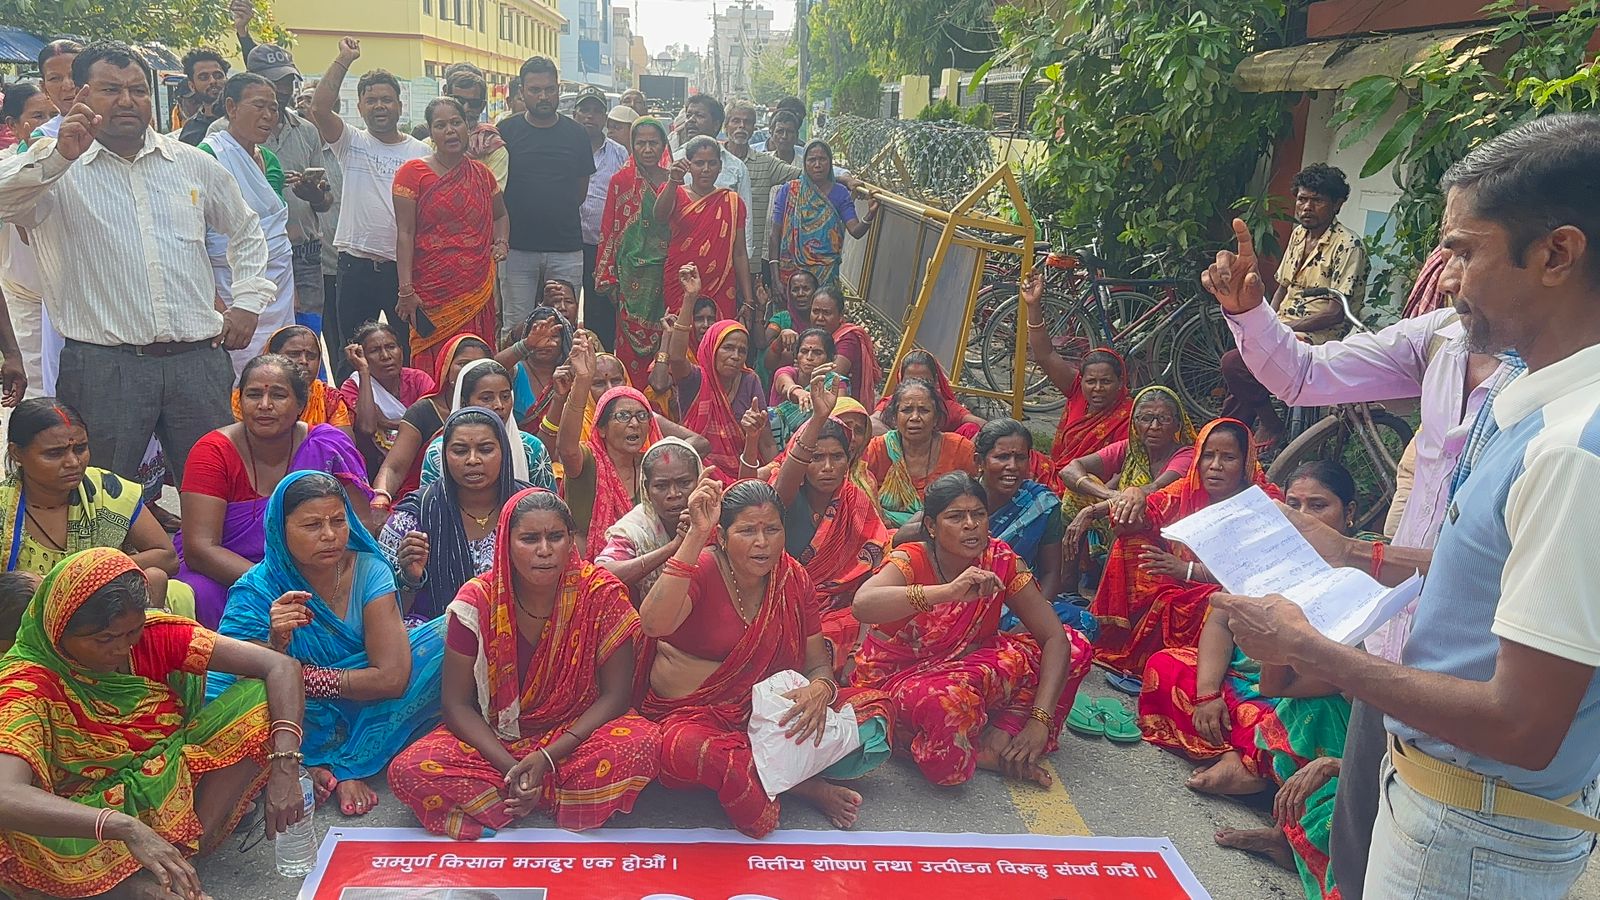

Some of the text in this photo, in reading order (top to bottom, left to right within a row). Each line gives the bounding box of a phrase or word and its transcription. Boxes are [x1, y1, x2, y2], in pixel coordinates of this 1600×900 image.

[371, 854, 436, 873] सम्पुर्ण
[439, 854, 507, 868] किसान
[513, 858, 576, 873] मजदुर
[582, 858, 615, 869] एक
[748, 856, 805, 870] वित्तीय
[812, 857, 866, 871] शोषण
[873, 861, 912, 871] तथा
[918, 859, 991, 873] उत्पीडन
[1053, 862, 1099, 875] संघर्ष
